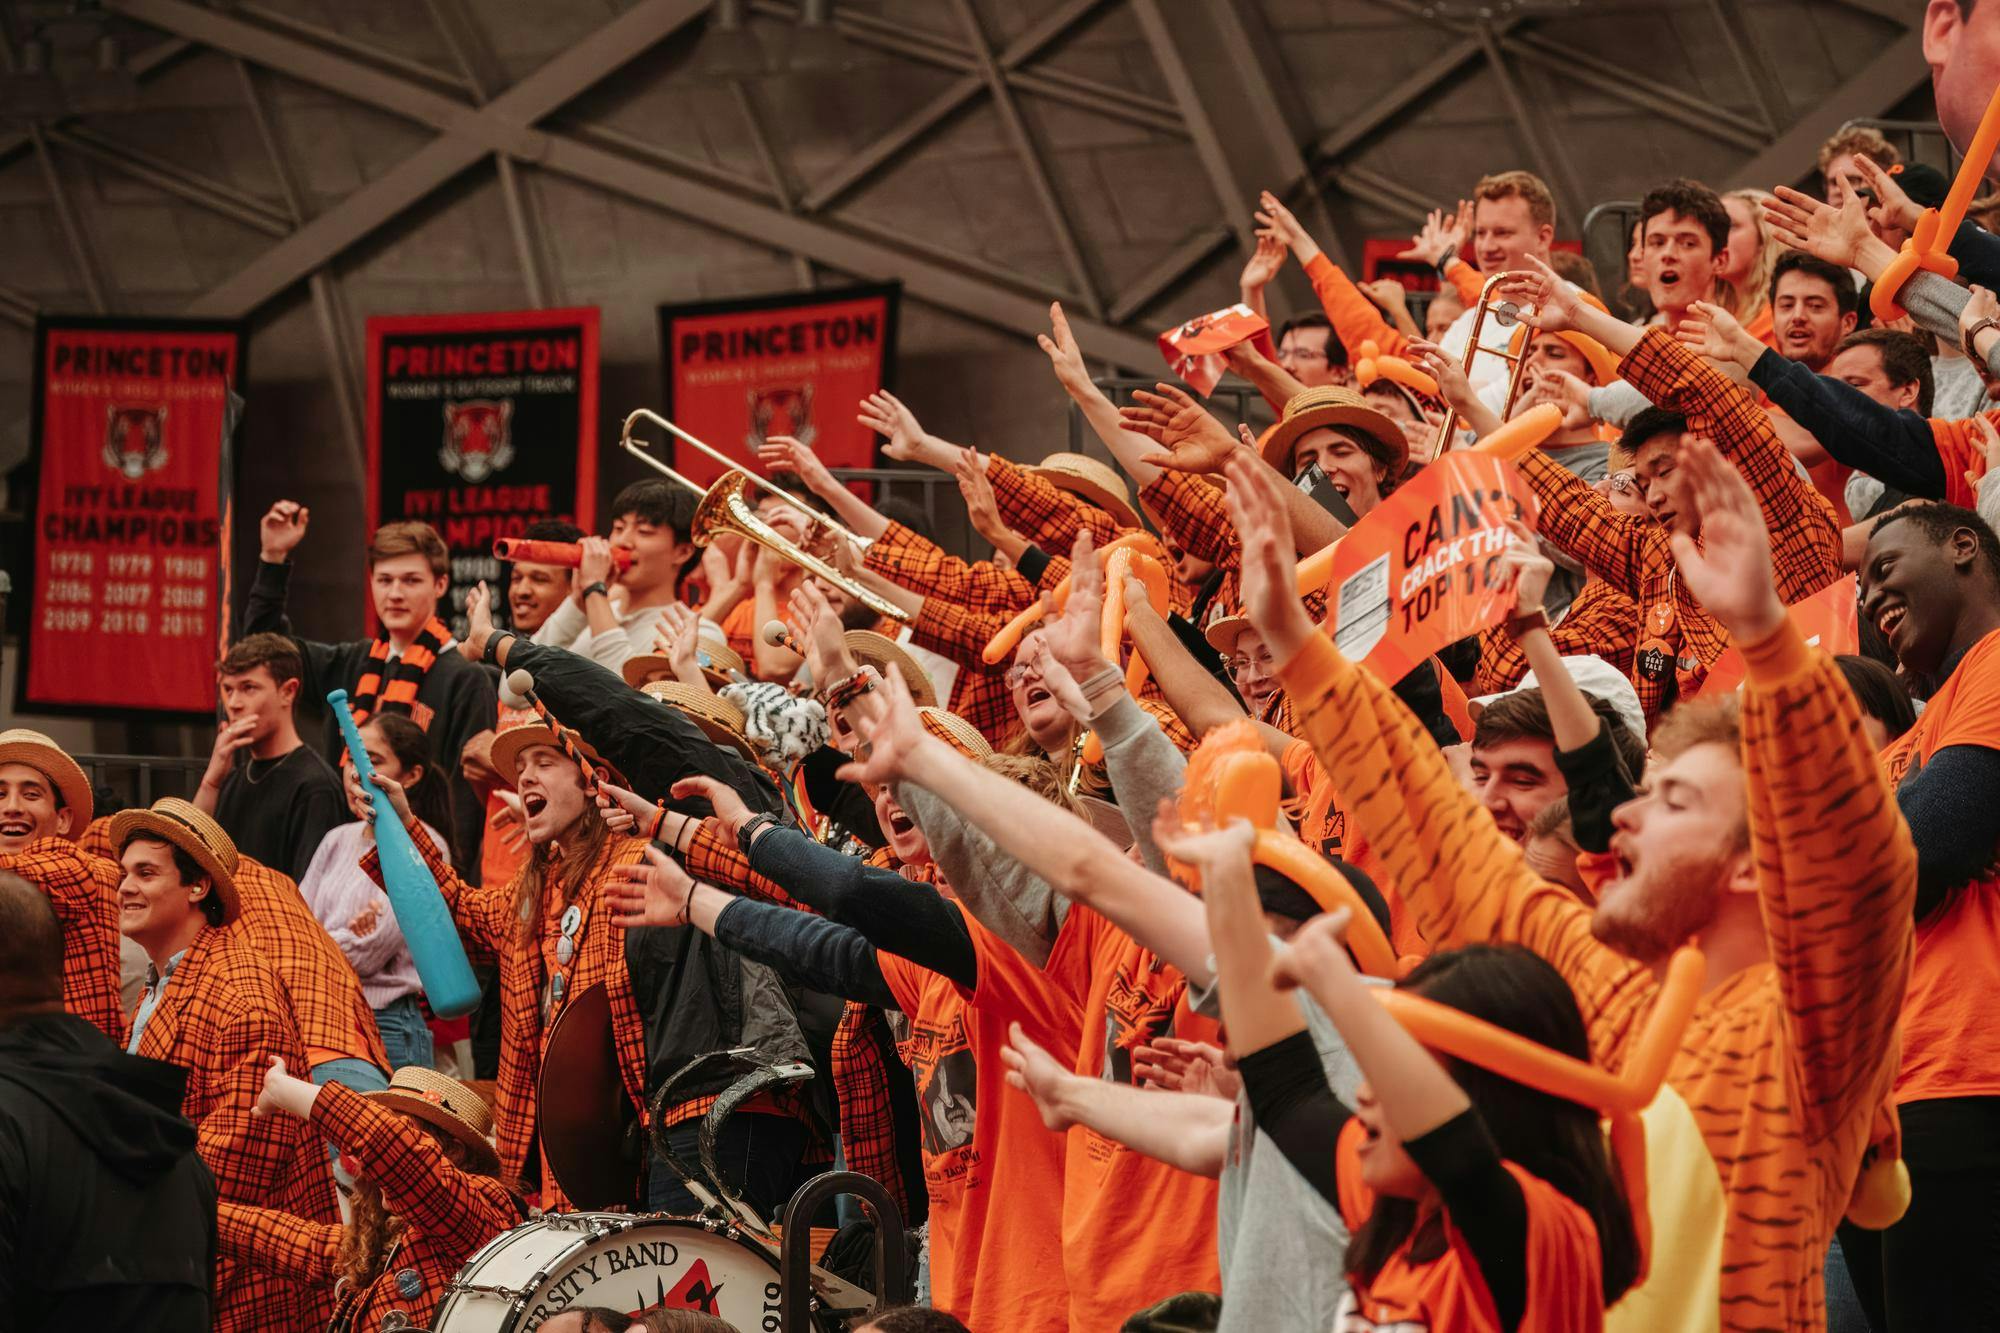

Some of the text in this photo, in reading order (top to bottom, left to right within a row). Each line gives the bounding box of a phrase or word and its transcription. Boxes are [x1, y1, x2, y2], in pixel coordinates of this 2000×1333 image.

[680, 315, 878, 363] PRINCETON
[54, 346, 227, 379] PRINCETON
[387, 337, 578, 376] PRINCETON
[64, 486, 198, 513] IVY LEAGUE
[404, 485, 549, 514] IVY LEAGUE
[44, 513, 218, 548] CHAMPIONS
[108, 554, 152, 577] 1979
[1401, 537, 1466, 601] CRACK
[104, 582, 150, 606] 2007
[1401, 573, 1452, 634] TOP
[101, 611, 148, 634] 2010
[1645, 656, 1664, 666] BEAT
[1645, 662, 1663, 672] YALE
[604, 1241, 679, 1275] BAND
